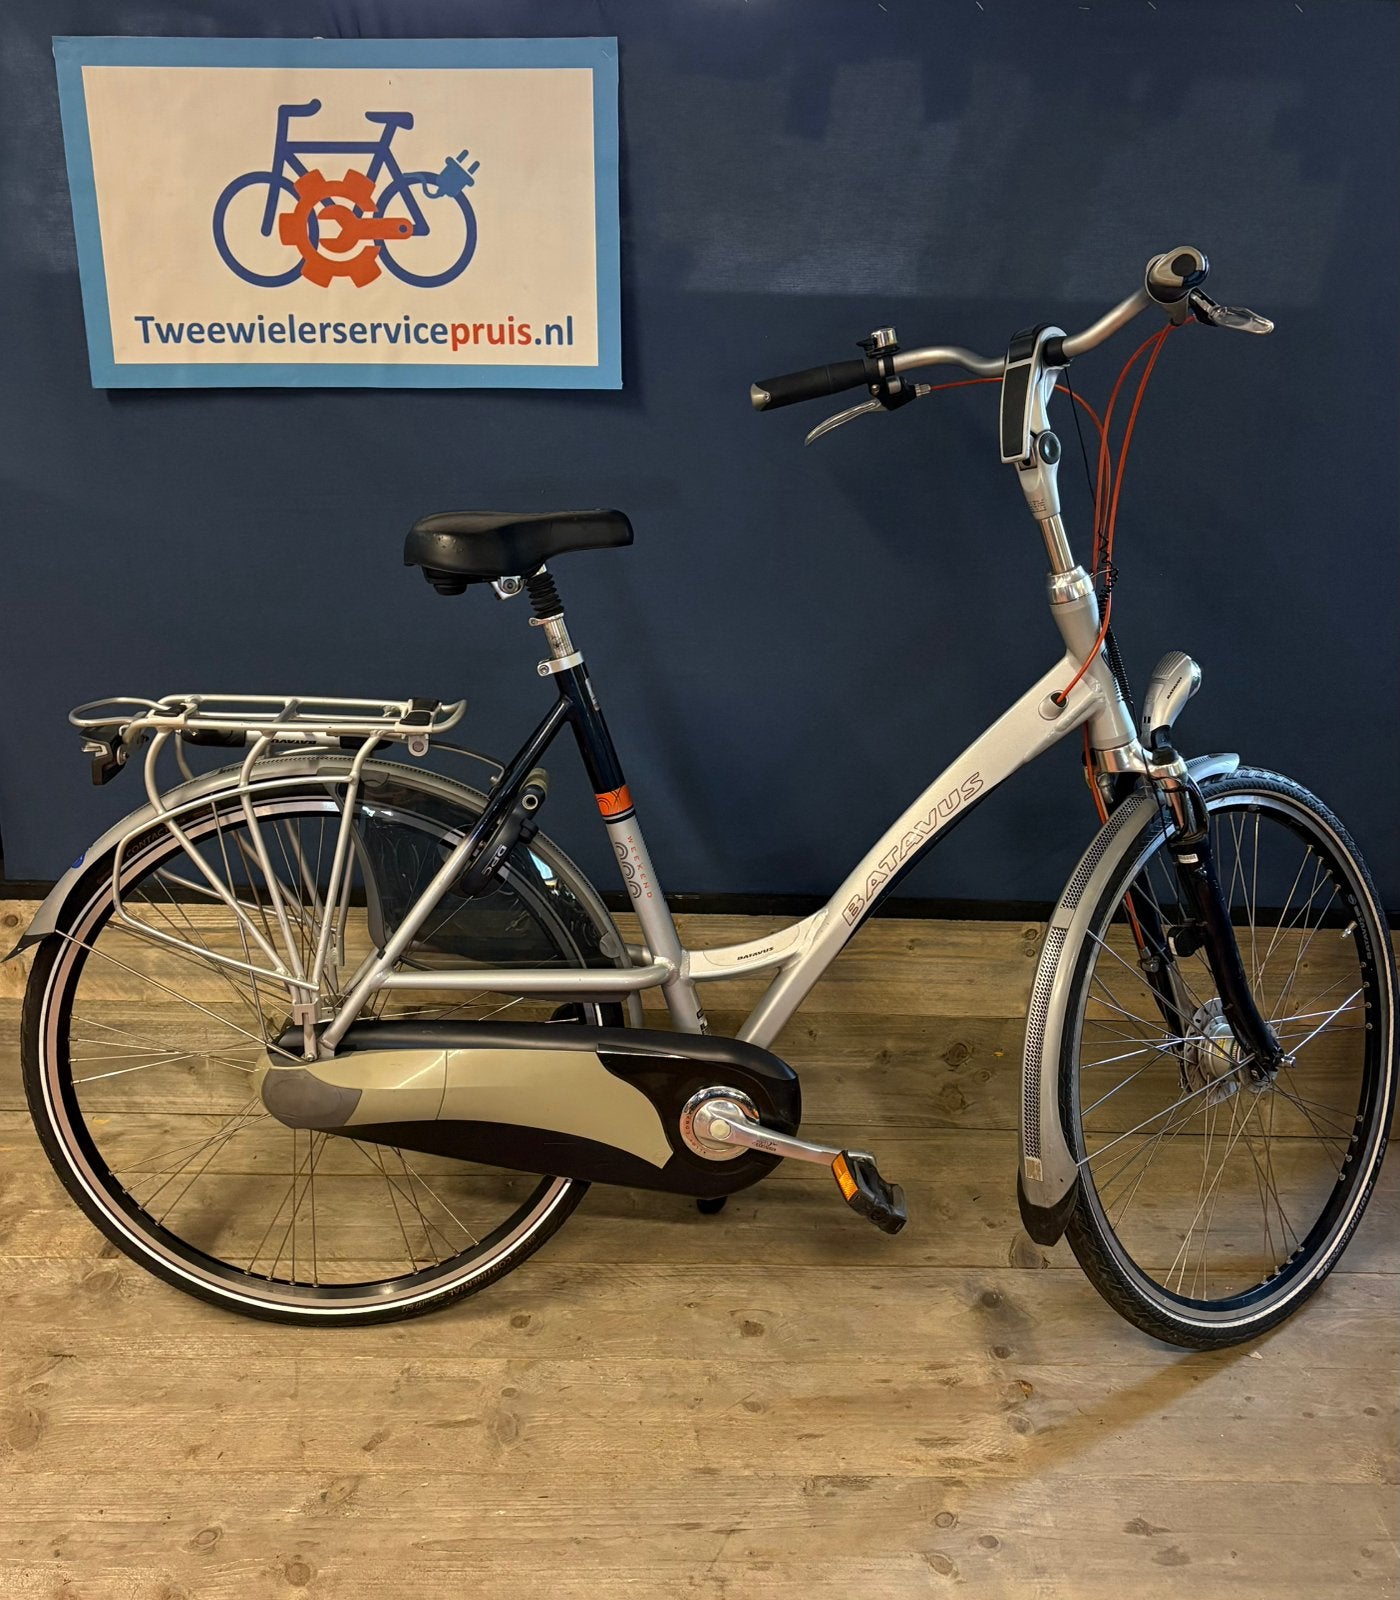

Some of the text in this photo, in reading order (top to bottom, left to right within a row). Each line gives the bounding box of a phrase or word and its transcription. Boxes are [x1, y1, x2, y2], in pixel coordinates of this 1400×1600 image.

[134, 314, 574, 352] Tweewielerservicepruis.nl
[627, 835, 653, 899] WEEKEND
[842, 771, 984, 927] BATAVUS
[737, 946, 774, 960] BATAVUS
